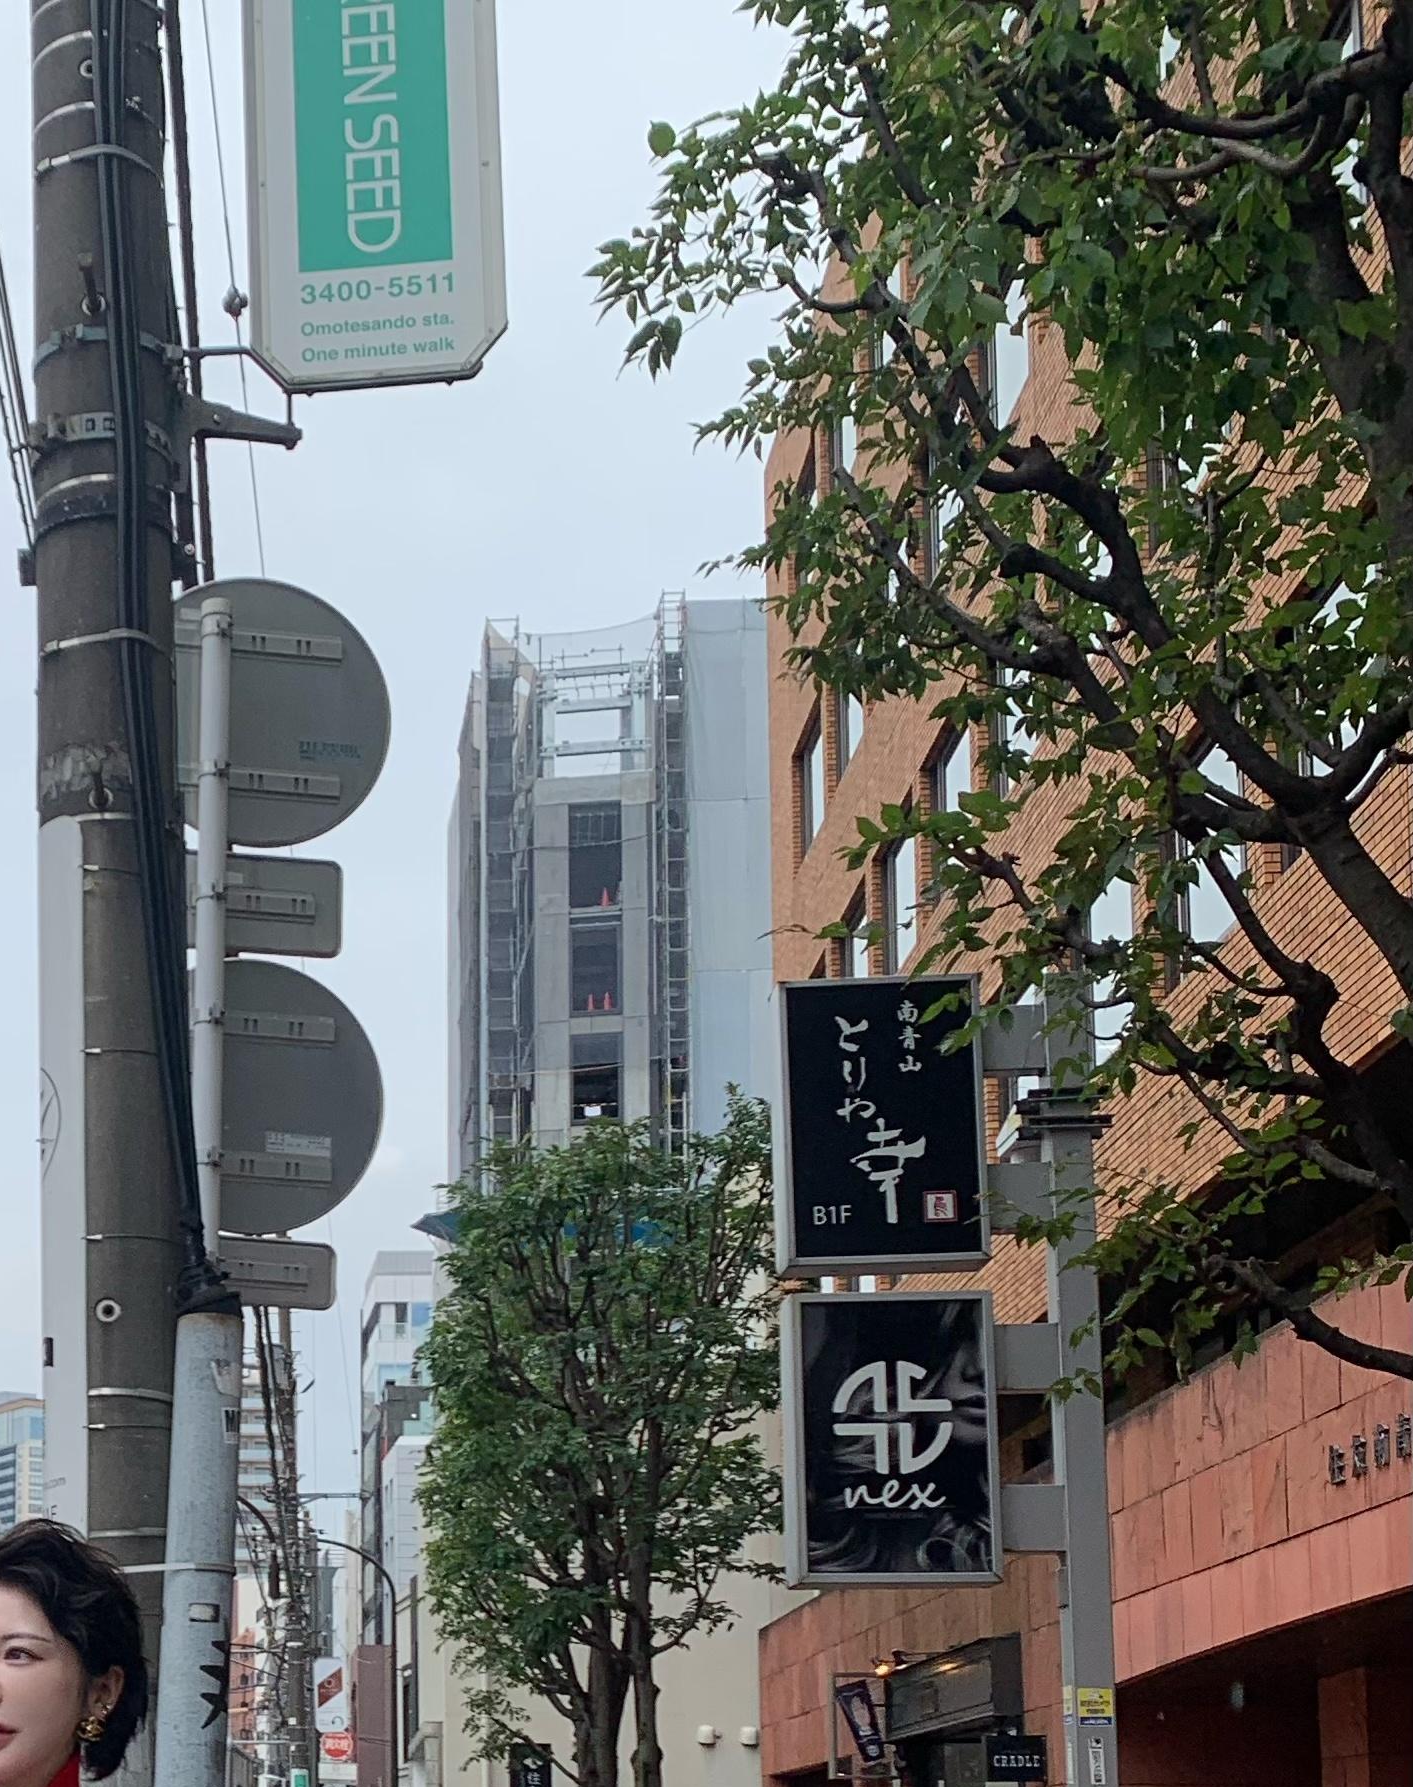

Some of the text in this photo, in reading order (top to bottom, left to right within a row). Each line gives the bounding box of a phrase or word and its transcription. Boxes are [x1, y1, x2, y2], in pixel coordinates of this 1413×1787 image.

[340, 0, 401, 253] EEN SEED
[299, 272, 455, 305] 3400-5511
[300, 311, 455, 337] Omotesando sta.
[301, 337, 455, 364] One minute walk
[896, 999, 923, 1073] 南青山
[812, 1205, 853, 1226] B1F
[844, 1479, 947, 1510] nex
[993, 1755, 1041, 1768] CRADLE
